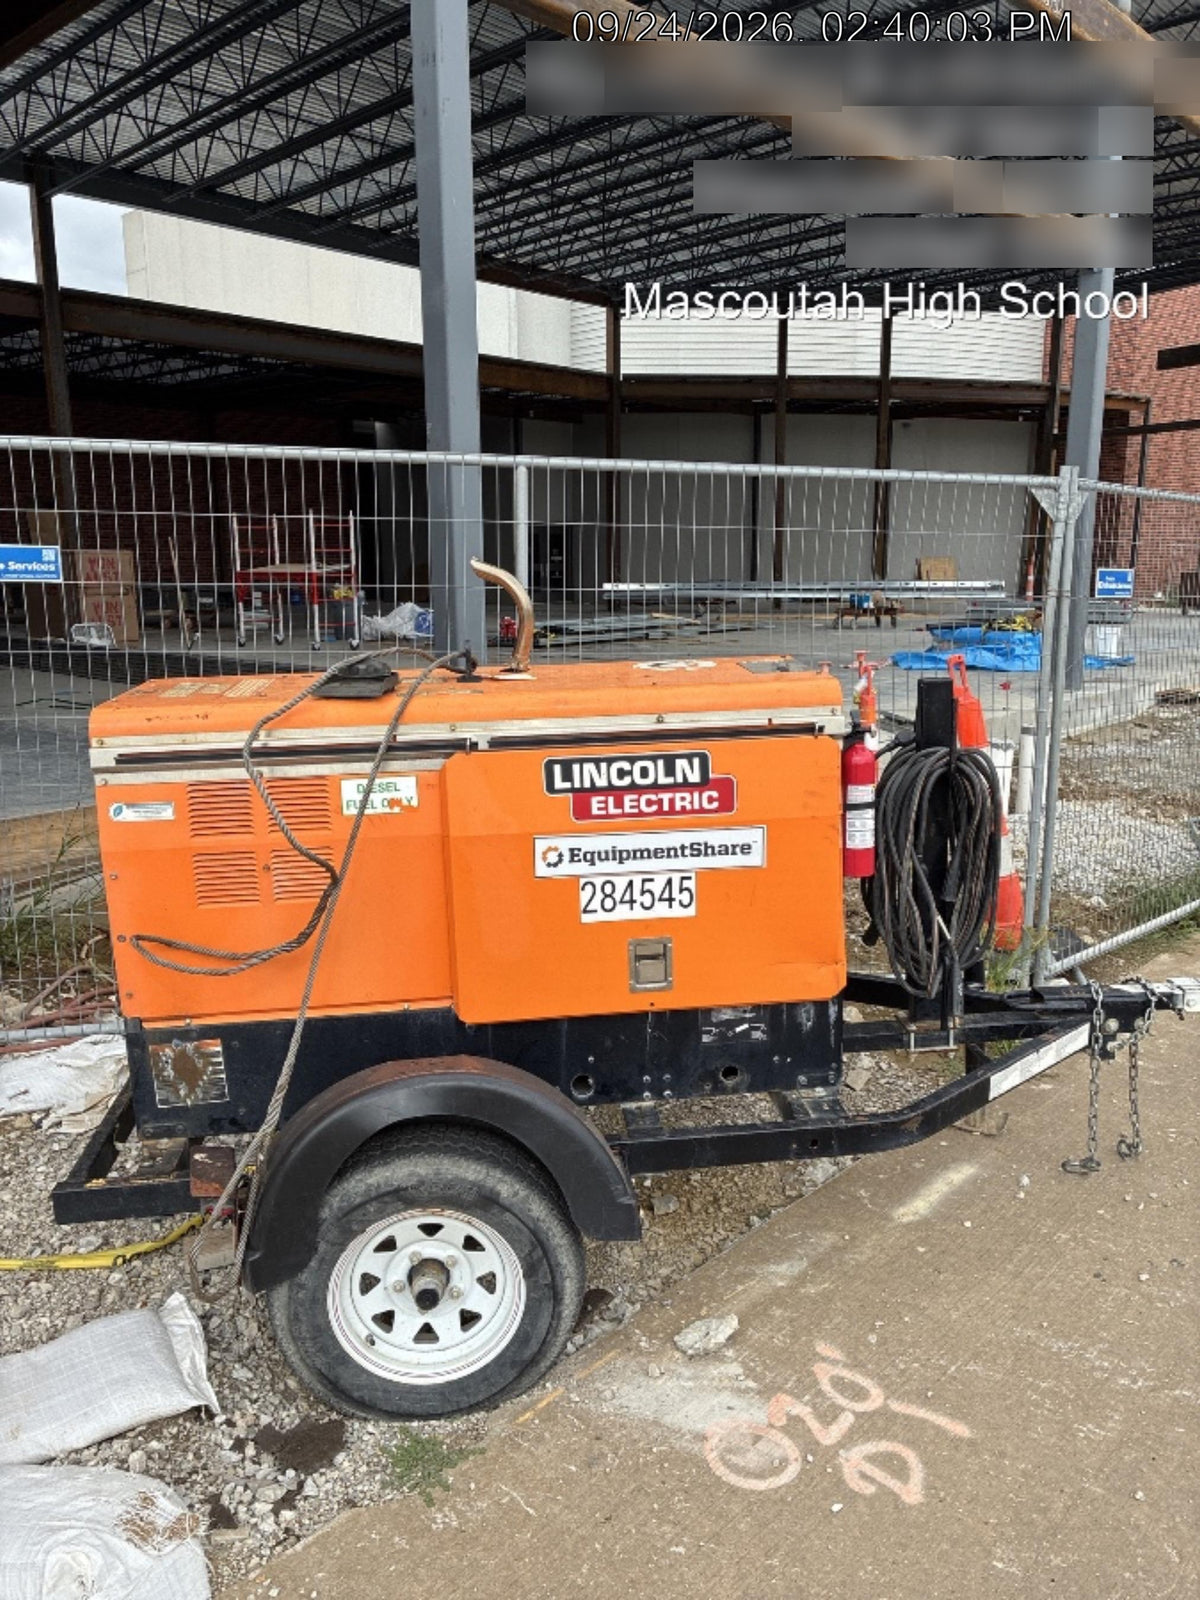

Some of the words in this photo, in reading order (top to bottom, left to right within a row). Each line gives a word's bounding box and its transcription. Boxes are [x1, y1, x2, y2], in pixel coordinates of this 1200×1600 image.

[553, 757, 702, 790] LINCOLN
[356, 782, 401, 794] DESEL
[590, 790, 719, 815] ELECTRIC
[568, 841, 753, 867] EquipmentShare
[581, 876, 694, 914] 284545
